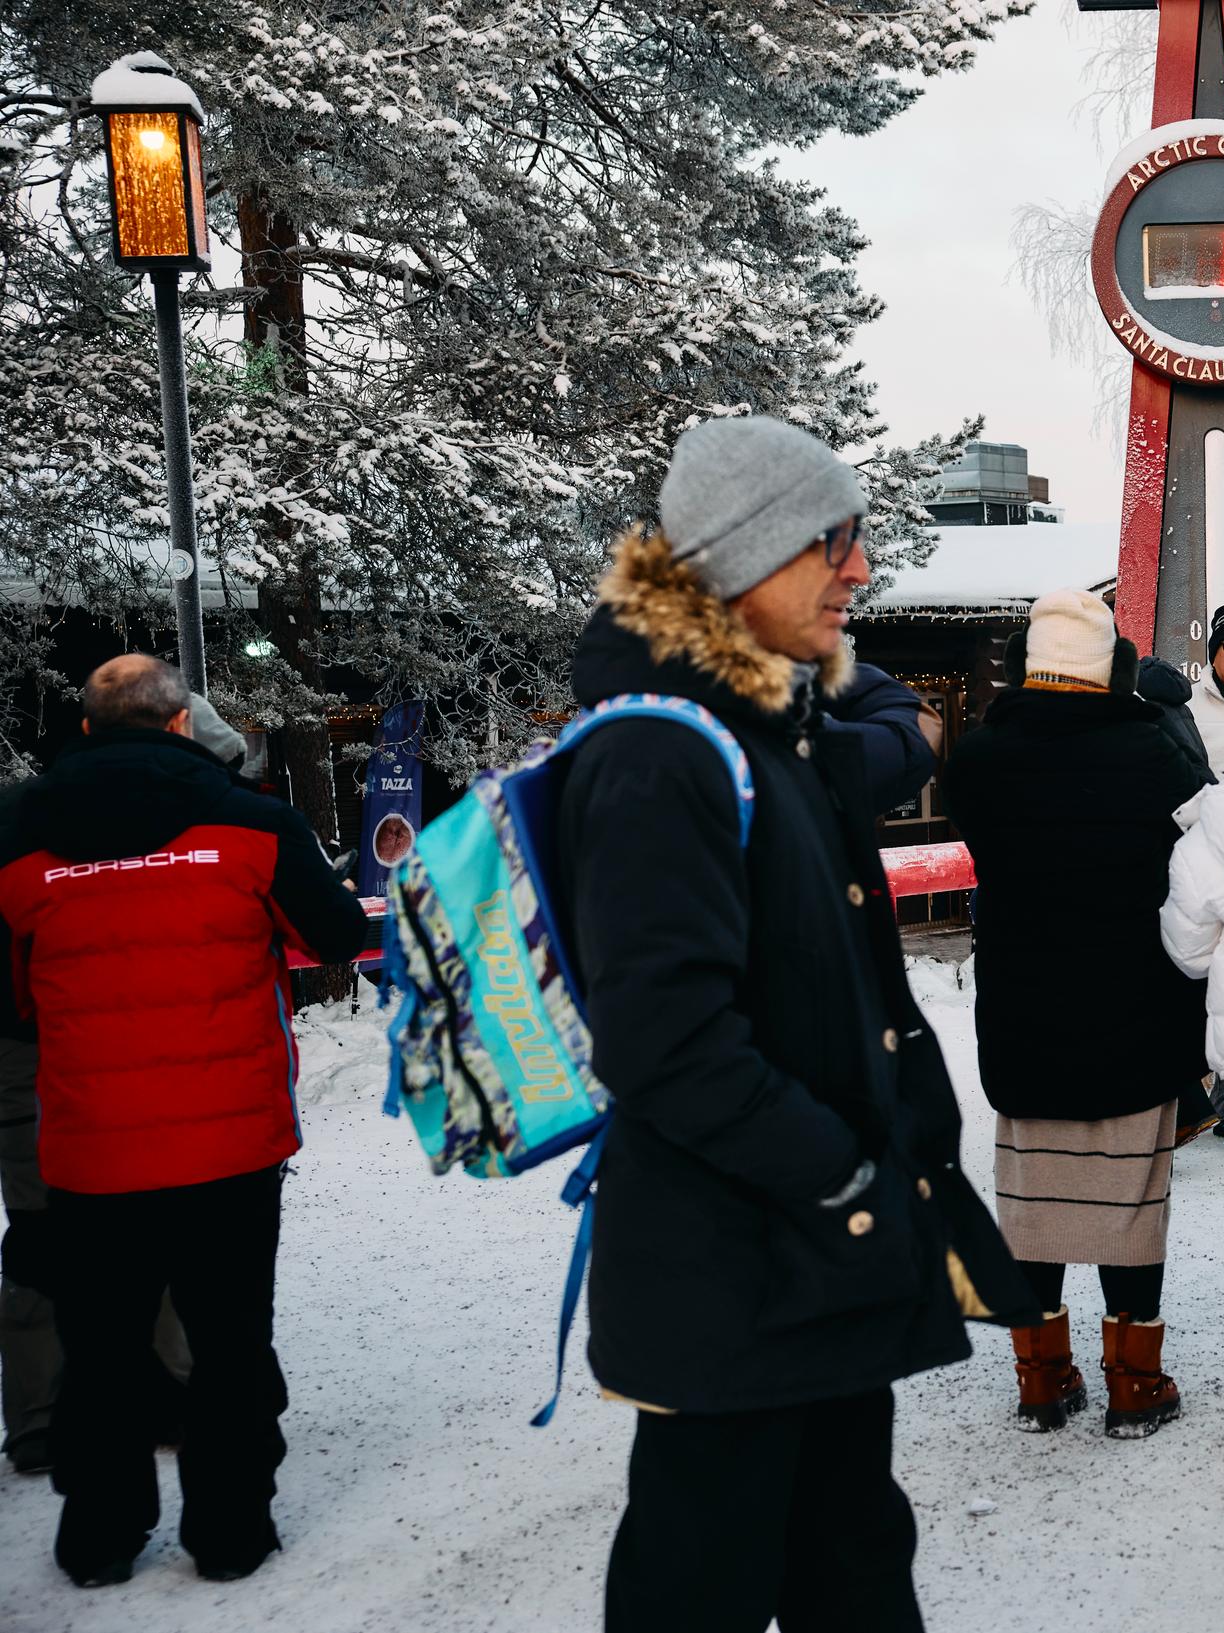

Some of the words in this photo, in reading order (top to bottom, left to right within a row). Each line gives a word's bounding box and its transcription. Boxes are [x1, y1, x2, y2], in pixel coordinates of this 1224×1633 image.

[1126, 136, 1207, 192] ARCTIC
[1112, 313, 1168, 370] SANTA
[1190, 620, 1203, 641] 0
[381, 777, 413, 791] TAZZA
[44, 849, 220, 884] PORSCHE
